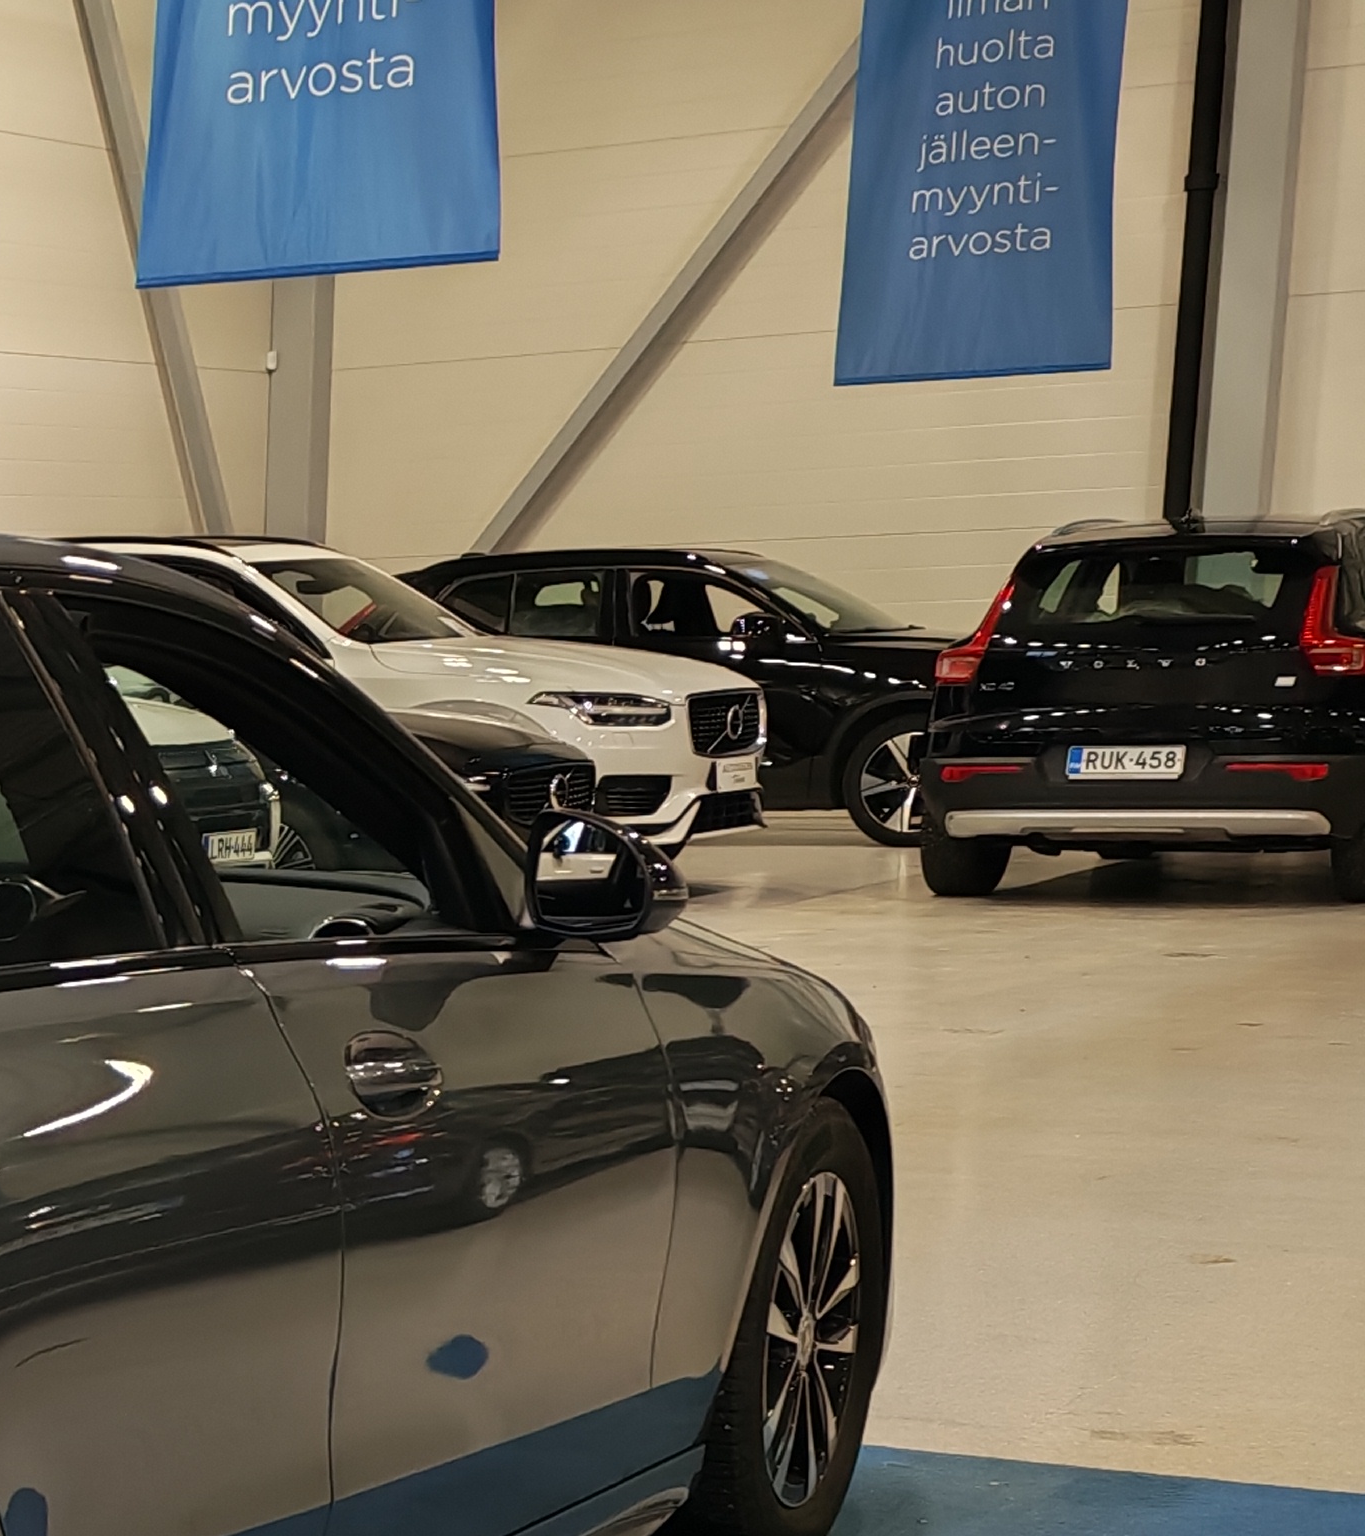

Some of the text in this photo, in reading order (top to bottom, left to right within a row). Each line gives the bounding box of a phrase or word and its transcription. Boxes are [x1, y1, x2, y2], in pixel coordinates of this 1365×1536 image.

[935, 29, 1055, 69] huolta
[226, 49, 416, 104] arvosta
[935, 82, 1046, 117] auton
[917, 130, 1057, 172] jälleen-
[911, 172, 1060, 216] myynti-
[909, 223, 1052, 260] arvosta
[1085, 750, 1177, 770] RUK-458
